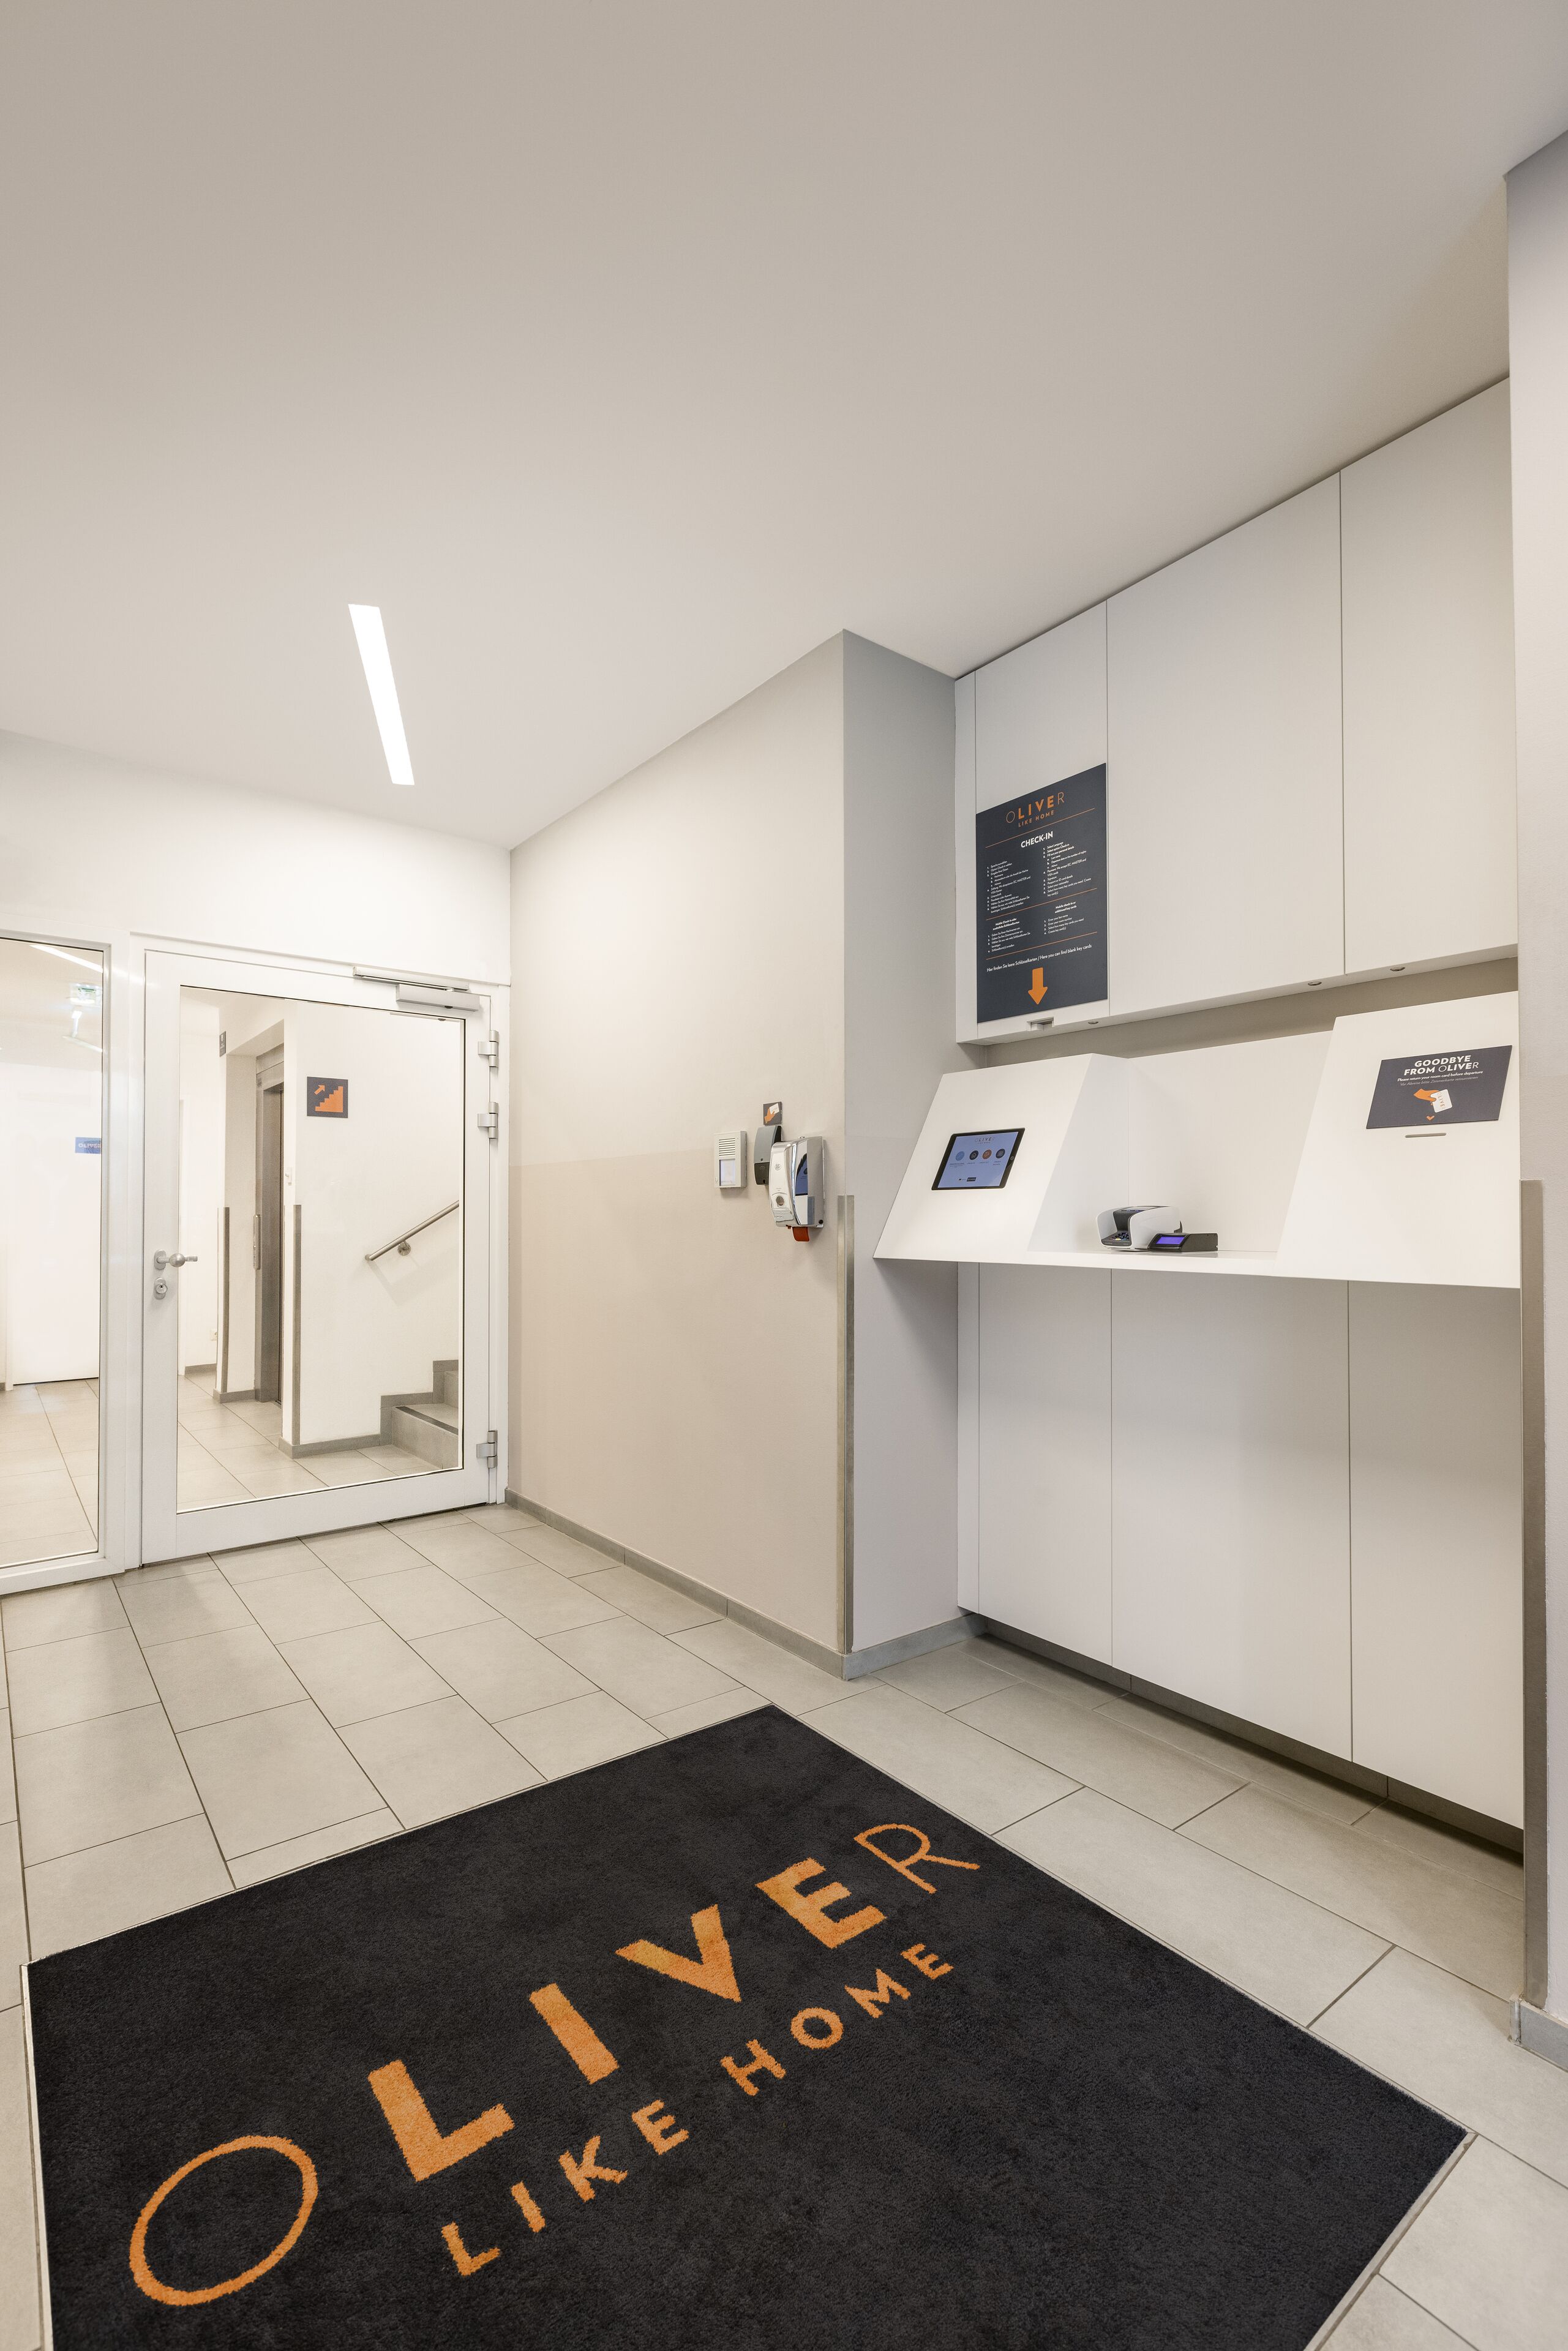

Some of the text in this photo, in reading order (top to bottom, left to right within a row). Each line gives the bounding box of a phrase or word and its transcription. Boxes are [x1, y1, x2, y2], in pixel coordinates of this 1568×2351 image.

[1006, 792, 1064, 823] OLIVER
[1018, 811, 1054, 827] LIKE HOME
[1021, 831, 1053, 848] CHECK-IN
[1016, 956, 1037, 966] Schlüsselkarten
[1404, 1062, 1479, 1076] FROM OLIVER
[1414, 1055, 1471, 1067] GOODBYE
[130, 1824, 980, 2306] OLIVER
[441, 1943, 953, 2276] LIKE HOME
